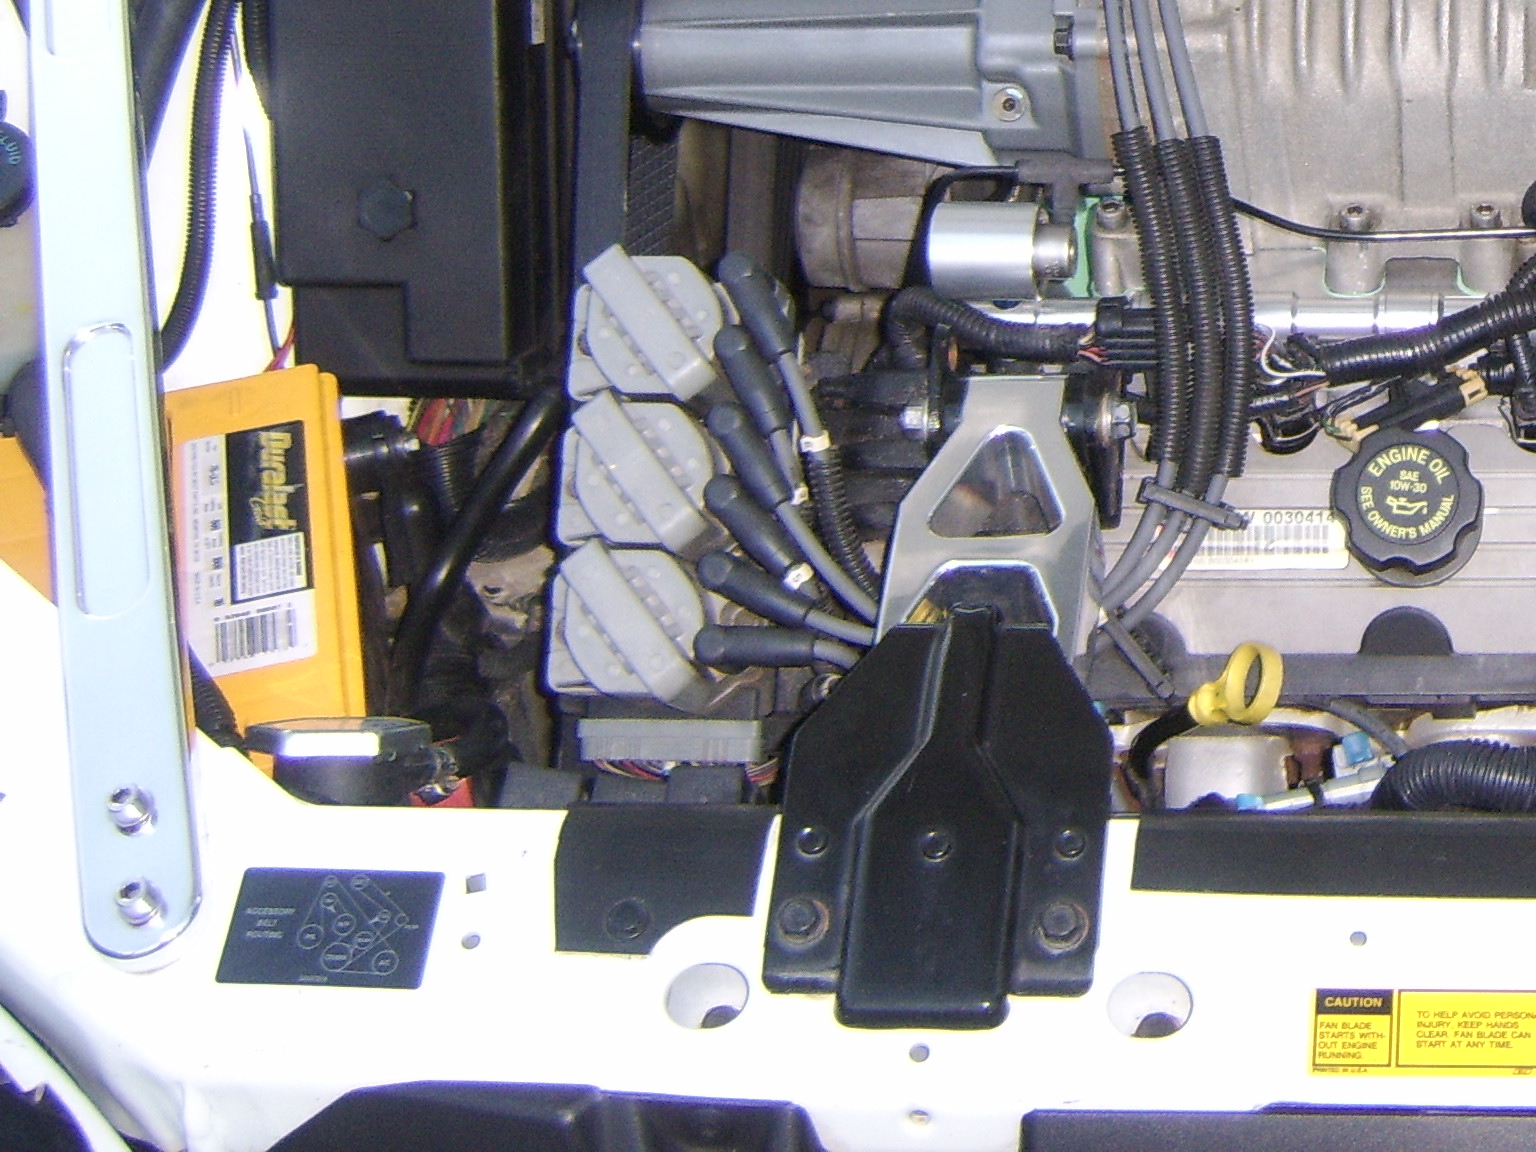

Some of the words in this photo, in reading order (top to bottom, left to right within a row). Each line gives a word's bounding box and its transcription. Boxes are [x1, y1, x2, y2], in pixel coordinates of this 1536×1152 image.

[1367, 446, 1431, 478] ENGINE
[1429, 458, 1451, 485] OIL
[257, 430, 305, 532] Duralast
[1400, 469, 1420, 482] SAE
[1389, 481, 1428, 494] 10W-30
[1360, 485, 1375, 512] SEE
[1419, 493, 1455, 536] MANUAL
[1367, 509, 1418, 540] OWNER'S
[1324, 997, 1383, 1008] CAUTION
[1416, 1010, 1431, 1019] TO
[1433, 1010, 1458, 1019] HELP
[1461, 1011, 1492, 1019] AVOID
[1319, 1021, 1338, 1030] FAN
[1341, 1021, 1373, 1030] BLADE
[1456, 1021, 1482, 1029] KEEP
[1486, 1021, 1520, 1029] HANDS
[1318, 1031, 1355, 1040] STARTS
[1357, 1031, 1387, 1040] WITH-
[1454, 1031, 1474, 1039] FAN
[1476, 1031, 1508, 1039] BLADE
[1511, 1031, 1532, 1039] CAN
[1318, 1041, 1339, 1050] OUT
[1341, 1041, 1378, 1050] ENGINE
[1416, 1041, 1447, 1049] START
[1449, 1041, 1464, 1049] AT
[1465, 1041, 1488, 1049] ANY
